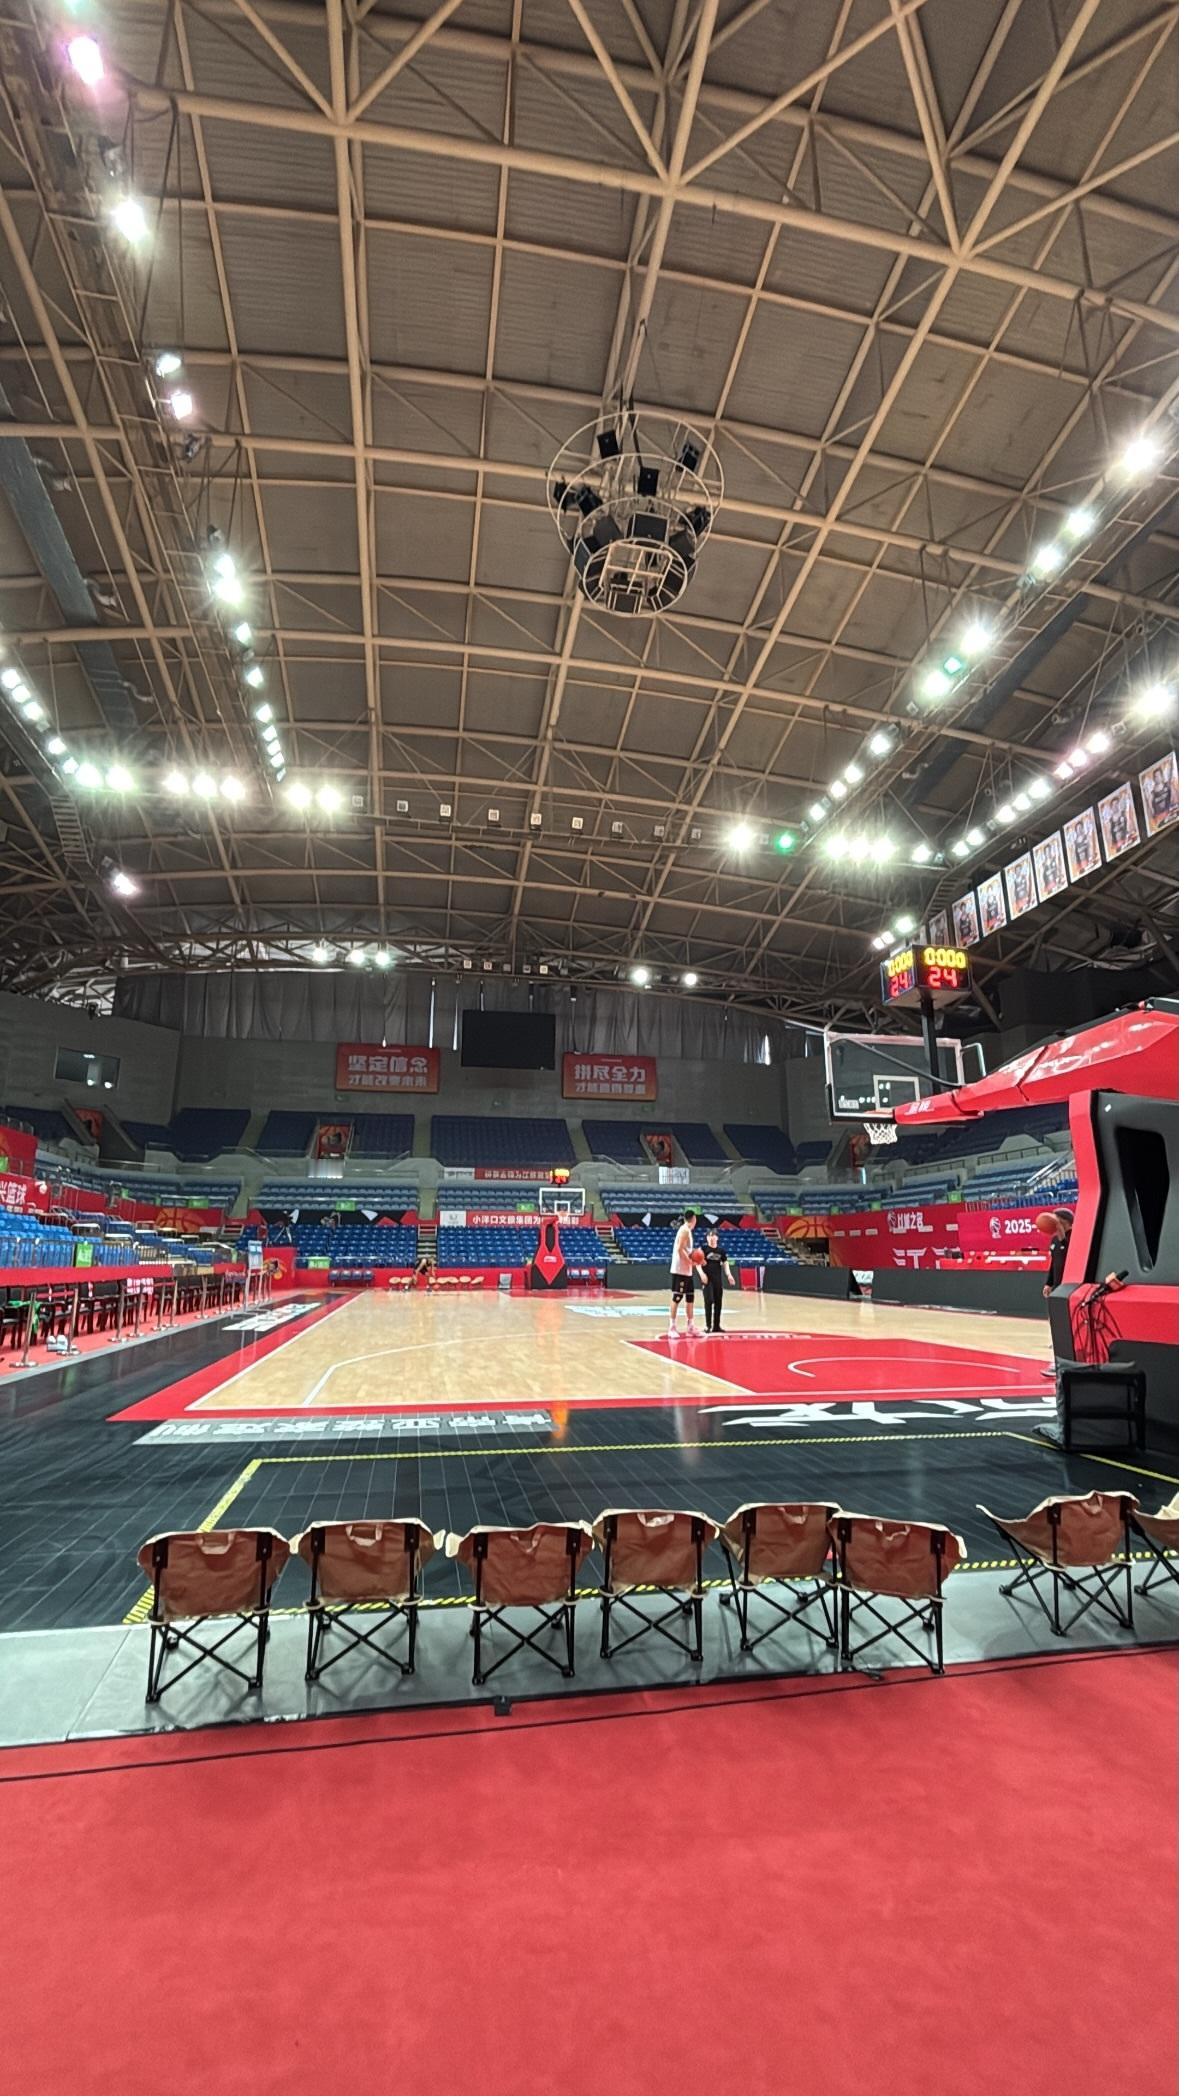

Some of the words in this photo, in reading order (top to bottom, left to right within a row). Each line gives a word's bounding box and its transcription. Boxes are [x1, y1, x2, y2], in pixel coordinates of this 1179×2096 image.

[891, 972, 908, 997] 24
[928, 967, 958, 987] 24
[348, 1055, 428, 1073] 坚定信念
[1004, 1218, 1040, 1234] 2025-
